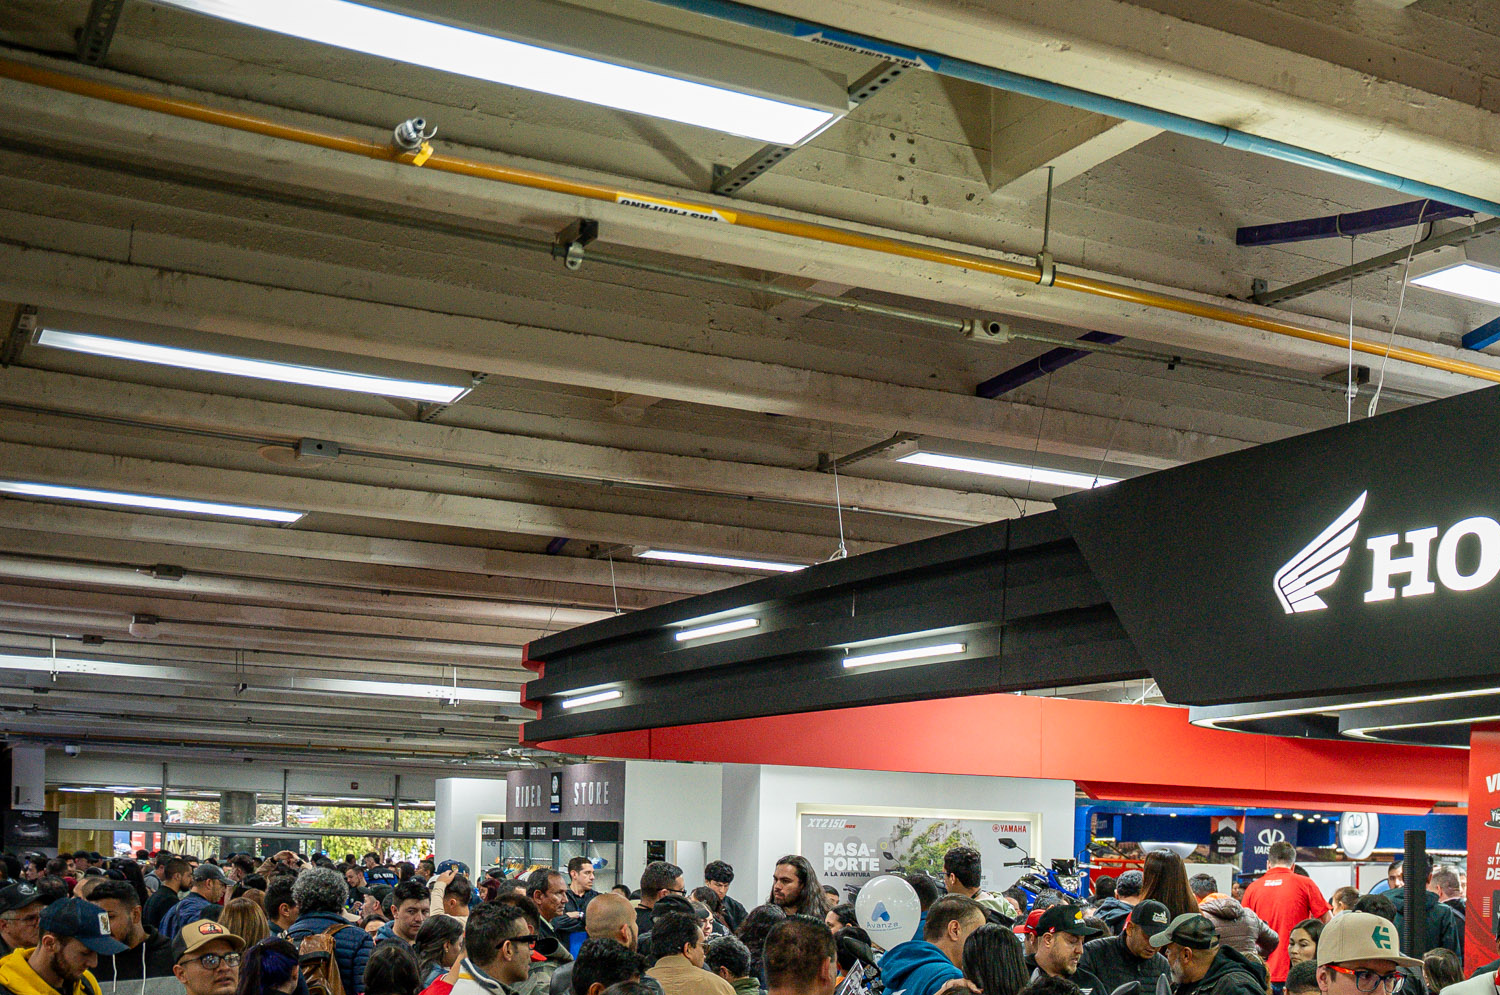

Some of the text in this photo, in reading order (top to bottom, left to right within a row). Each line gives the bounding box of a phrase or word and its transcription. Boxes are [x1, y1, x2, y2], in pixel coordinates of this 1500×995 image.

[515, 781, 609, 808] RIDER STORE
[1000, 824, 1027, 833] YAMAHA
[823, 842, 876, 857] PASA-
[823, 856, 880, 871] PORTE
[1487, 857, 1494, 865] SI
[866, 921, 899, 929] Avanza
